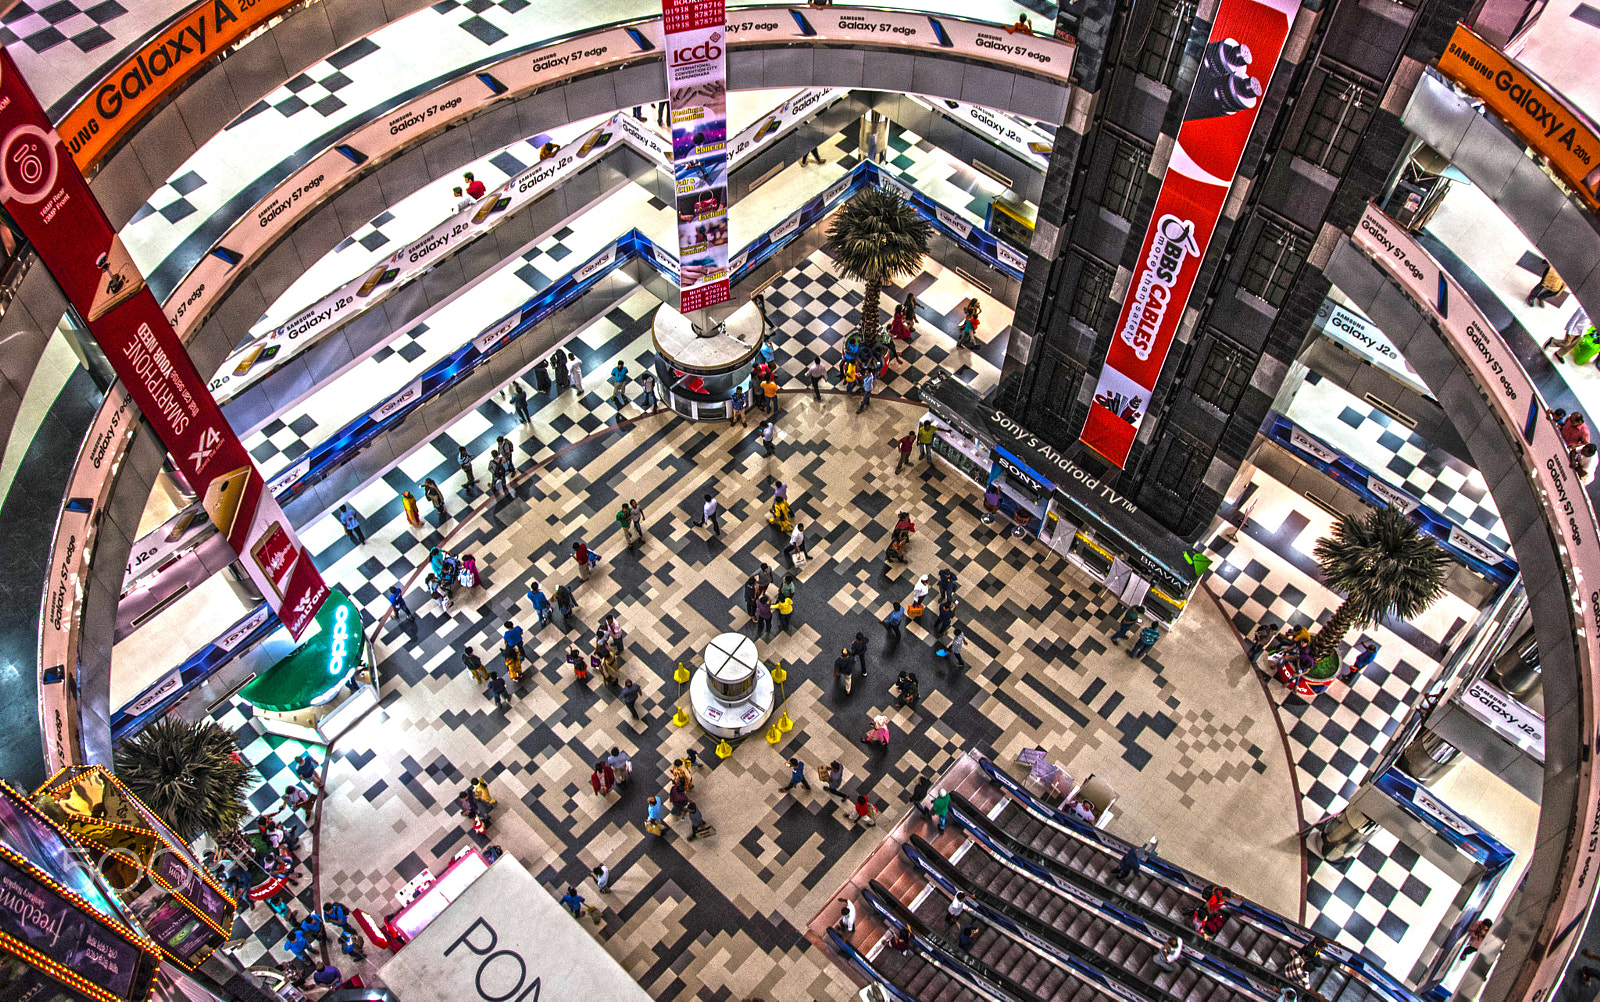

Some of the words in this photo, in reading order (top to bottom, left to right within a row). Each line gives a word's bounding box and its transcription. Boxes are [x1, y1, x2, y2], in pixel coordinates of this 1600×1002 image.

[742, 22, 753, 31] S7
[755, 22, 778, 31] edge
[838, 20, 877, 32] Galaxy
[879, 23, 892, 32] S7
[892, 26, 916, 35] edge
[96, 15, 206, 119] Galaxy
[215, 0, 238, 33] A
[533, 54, 570, 72] Galaxy
[571, 50, 582, 61] S7
[584, 46, 607, 58] edge
[975, 38, 1013, 54] Galaxy
[1015, 45, 1027, 56] S7
[1027, 51, 1051, 62] edge
[1448, 43, 1493, 80] SAMSUNG
[390, 113, 425, 135] Galaxy
[426, 105, 437, 117] S7
[439, 97, 462, 111] edge
[970, 109, 1005, 134] Galaxy
[1494, 70, 1565, 137] Galaxy
[1560, 128, 1577, 151] A
[1573, 145, 1591, 165] 2016
[696, 142, 726, 154] Concert
[519, 165, 555, 193] Galaxy
[259, 197, 293, 227] Galaxy
[291, 188, 304, 201] S7
[303, 174, 325, 192] edge
[698, 209, 727, 221] Fashion
[409, 233, 449, 262] Galaxy
[1151, 236, 1165, 267] more
[1157, 241, 1183, 283] BBS
[1361, 219, 1397, 252] Galaxy
[1392, 246, 1406, 260] S7
[1404, 258, 1424, 281] edge
[177, 303, 187, 317] S7
[187, 284, 205, 305] edge
[1140, 273, 1153, 301] than
[286, 310, 315, 331] SAMSUNG
[288, 308, 332, 339] Galaxy
[1124, 305, 1142, 342] safety
[1133, 284, 1167, 352] CABLES
[1332, 317, 1376, 348] Galaxy
[1336, 312, 1366, 330] SAMSUNG
[138, 322, 158, 353] NEED
[153, 346, 173, 379] YOUR
[1466, 325, 1495, 364] Galaxy
[1492, 359, 1504, 377] S7
[1500, 374, 1517, 400] edge
[123, 333, 189, 435] SMARTPHONE
[170, 370, 185, 391] sense
[181, 389, 192, 404] can
[188, 400, 200, 417] that
[94, 425, 115, 469] Galaxy
[112, 410, 121, 427] S7
[119, 393, 132, 413] edg
[188, 426, 220, 471] X4
[991, 410, 1039, 447] Sony's
[1038, 445, 1100, 490] Android
[998, 457, 1042, 491] SONY
[1547, 459, 1568, 502] Galaxy
[1564, 500, 1575, 516] S7
[1569, 517, 1582, 546] edge
[54, 581, 67, 631] Galaxy
[61, 562, 69, 581] S7
[66, 535, 75, 565] edge
[1140, 555, 1182, 589] BRAVIA
[291, 585, 325, 632] WALTON
[1469, 688, 1519, 724] Galaxy
[1475, 685, 1507, 707] SAMSUNG
[3, 876, 24, 896] Napkin
[23, 891, 45, 910] Sanitary
